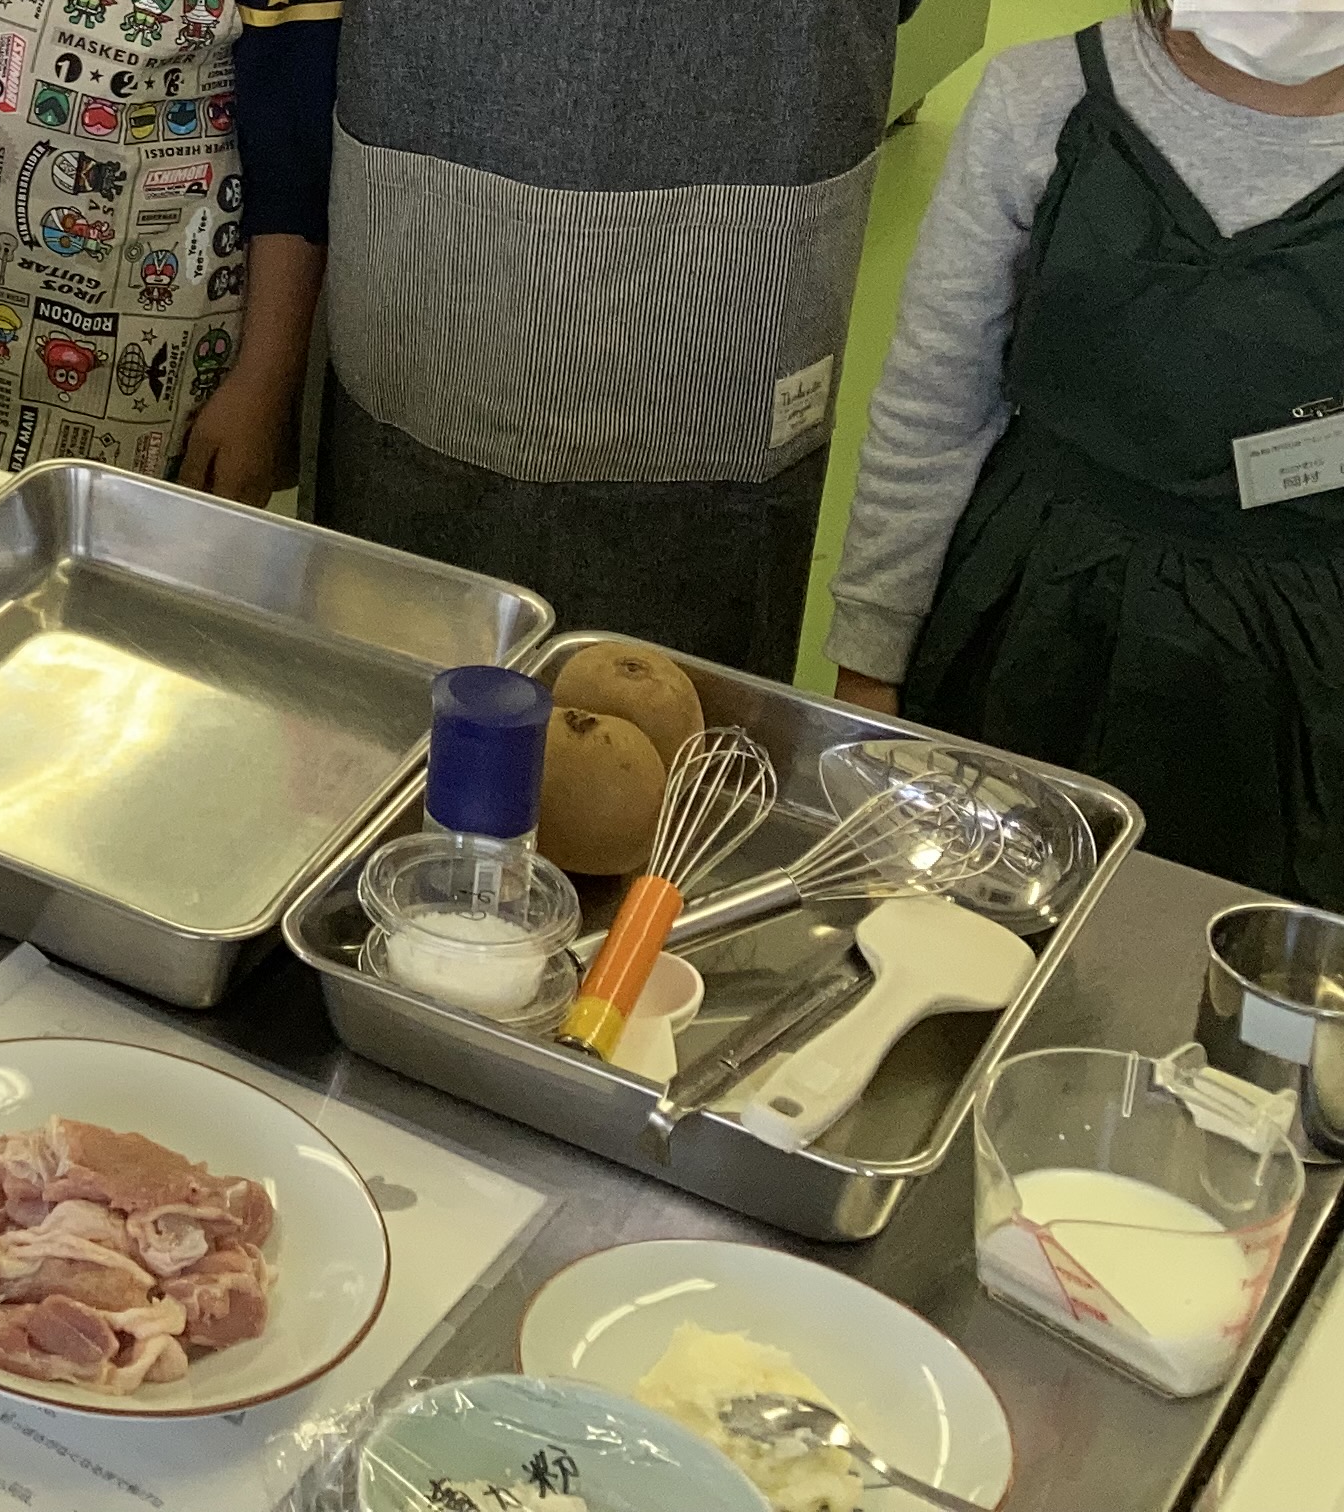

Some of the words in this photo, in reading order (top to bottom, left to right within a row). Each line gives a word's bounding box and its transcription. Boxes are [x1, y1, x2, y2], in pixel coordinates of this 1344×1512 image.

[57, 31, 140, 66] MASKED
[17, 257, 101, 291] GUITAR
[38, 302, 113, 332] ROBOCON
[163, 342, 180, 402] SHOCKER
[21, 410, 36, 445] MAN
